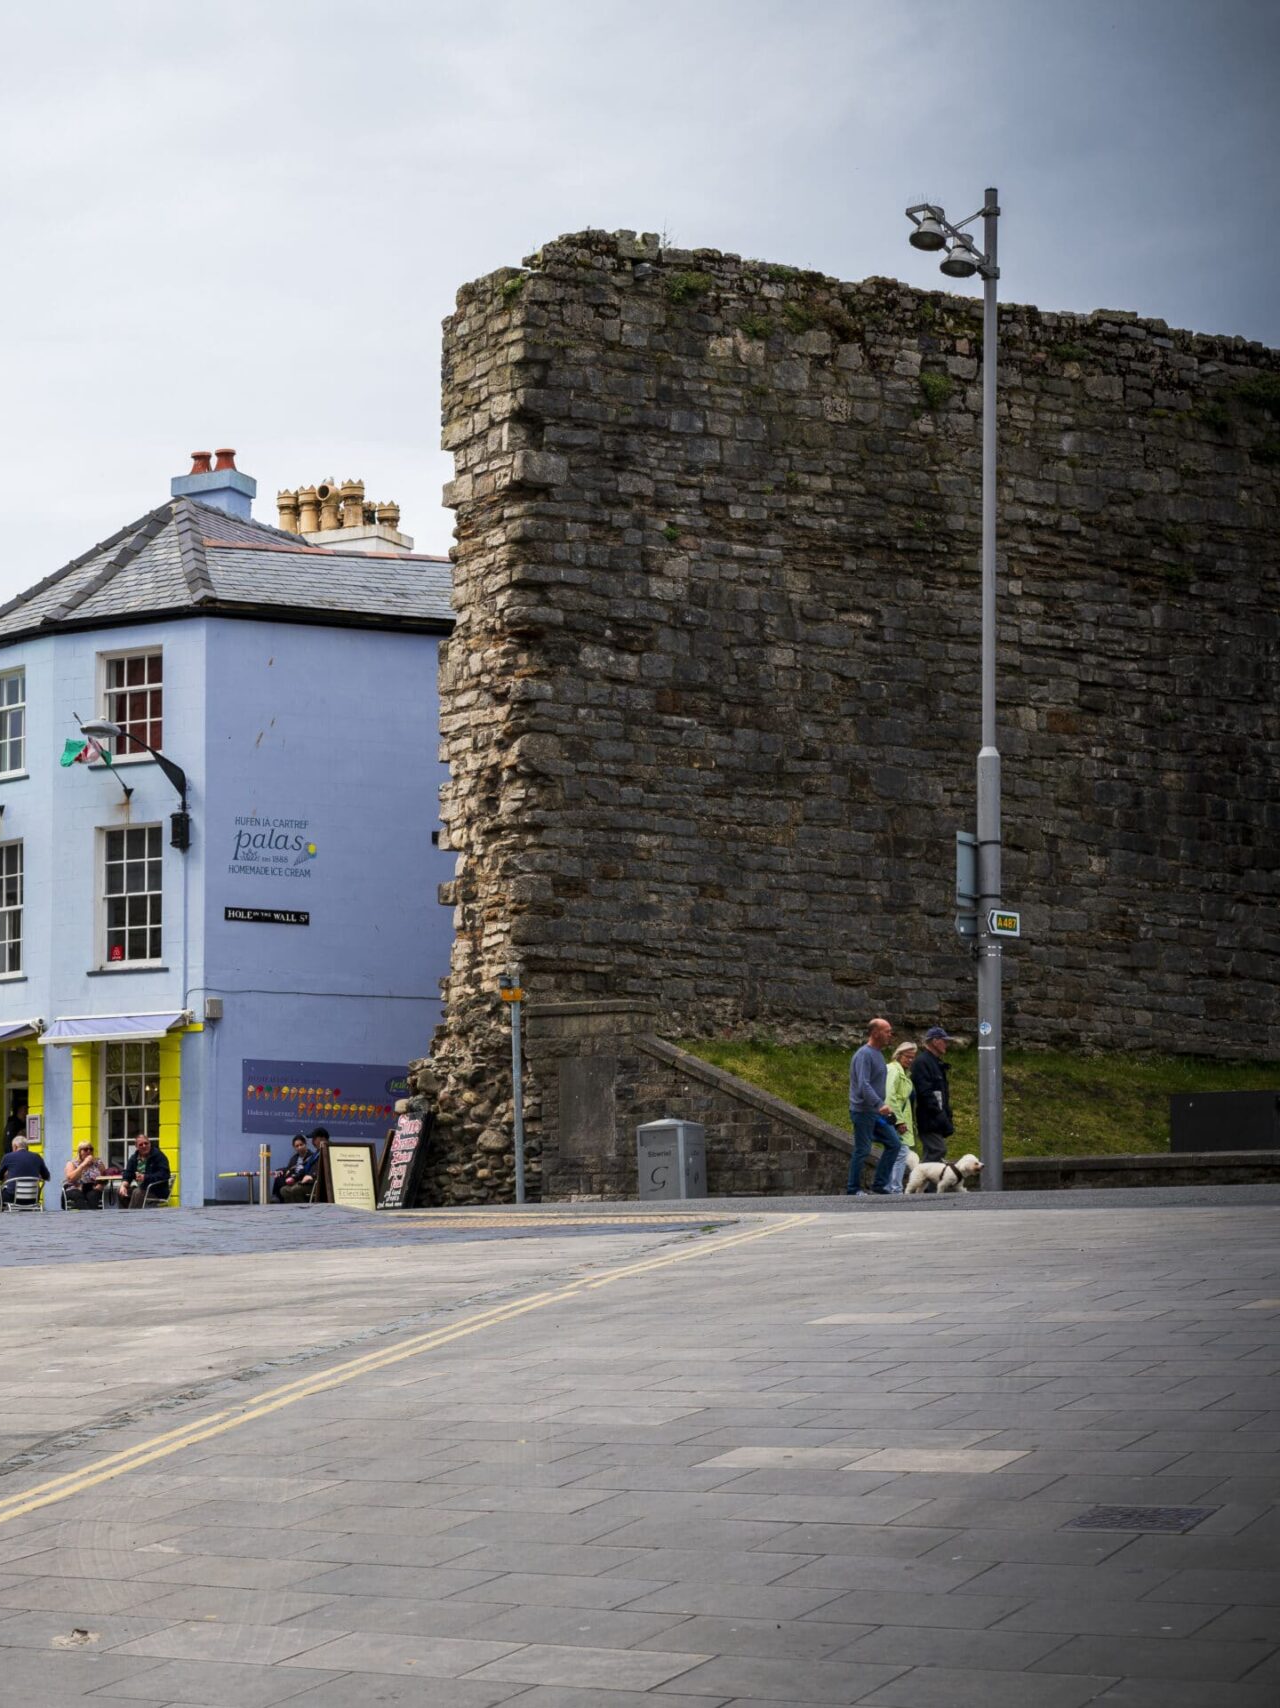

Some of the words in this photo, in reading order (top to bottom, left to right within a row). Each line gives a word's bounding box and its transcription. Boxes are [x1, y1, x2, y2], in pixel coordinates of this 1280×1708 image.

[235, 816, 261, 827] HUFEN
[272, 818, 309, 829] CARTREF
[232, 828, 304, 860] palas
[228, 864, 270, 876] HOMEMADE
[270, 866, 283, 877] ICE
[284, 867, 311, 878] CREAM
[227, 909, 253, 919] HOLE
[273, 912, 297, 922] WALL
[997, 916, 1017, 929] A487
